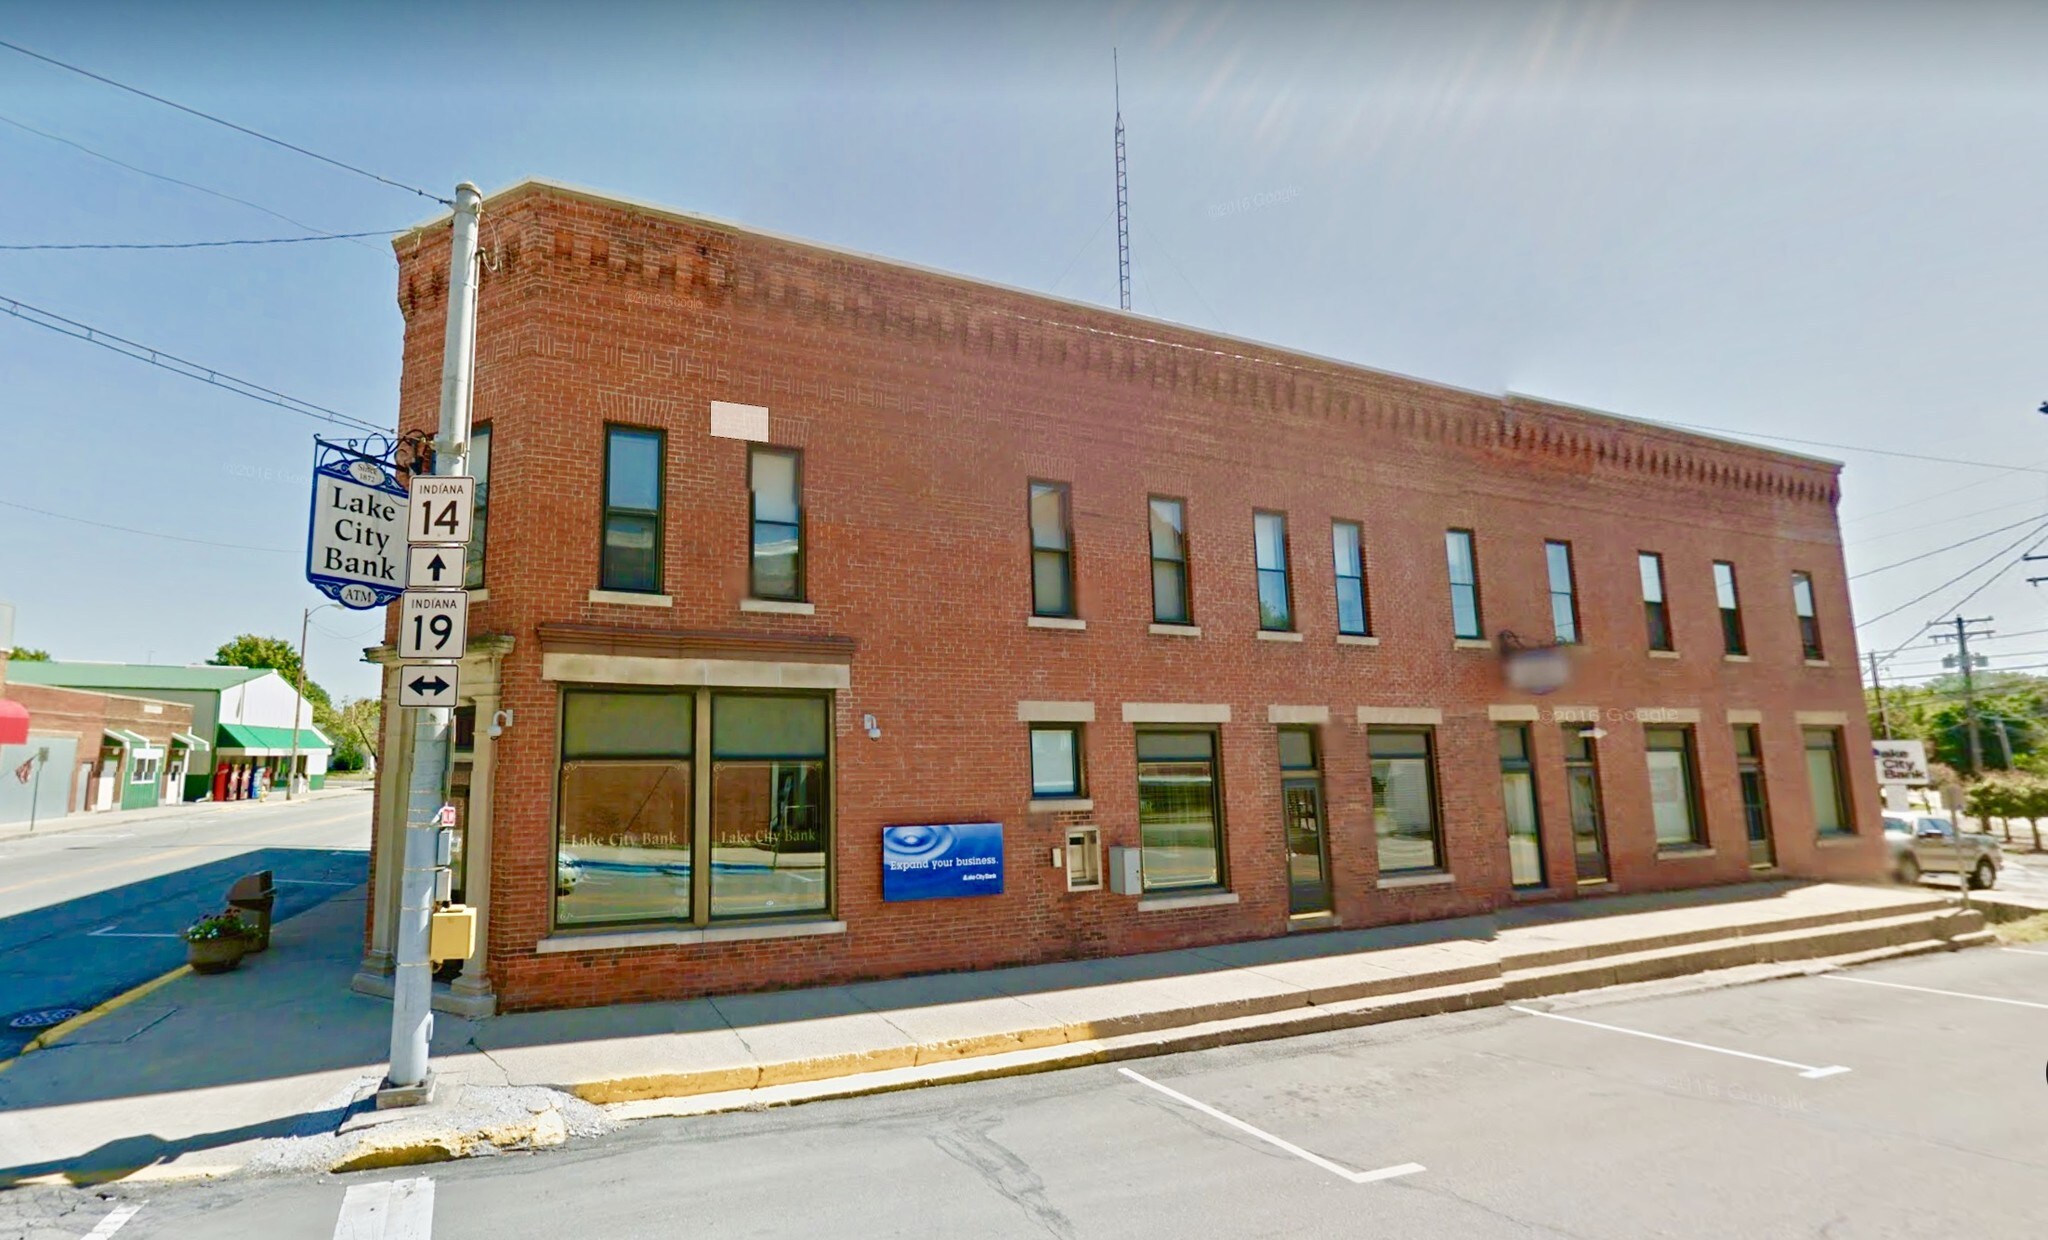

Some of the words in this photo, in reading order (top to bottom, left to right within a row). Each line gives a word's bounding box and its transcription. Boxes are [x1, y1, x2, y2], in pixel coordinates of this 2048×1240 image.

[419, 484, 465, 495] INDIANA
[332, 486, 396, 522] Lake
[422, 500, 460, 536] 14
[335, 518, 391, 556] City
[324, 546, 396, 581] Bank
[345, 588, 375, 603] ATM
[411, 598, 457, 610] INDIANA
[414, 614, 453, 651] 19
[1882, 759, 1915, 771] City
[1884, 769, 1926, 779] Bank
[571, 832, 604, 848] Lake
[609, 832, 637, 847] City
[642, 830, 678, 845] Bank
[721, 831, 751, 844] Lake
[755, 829, 781, 844] City
[785, 828, 816, 842] Bank
[890, 857, 929, 872] Expand
[932, 858, 953, 870] your
[955, 856, 999, 867] business.
